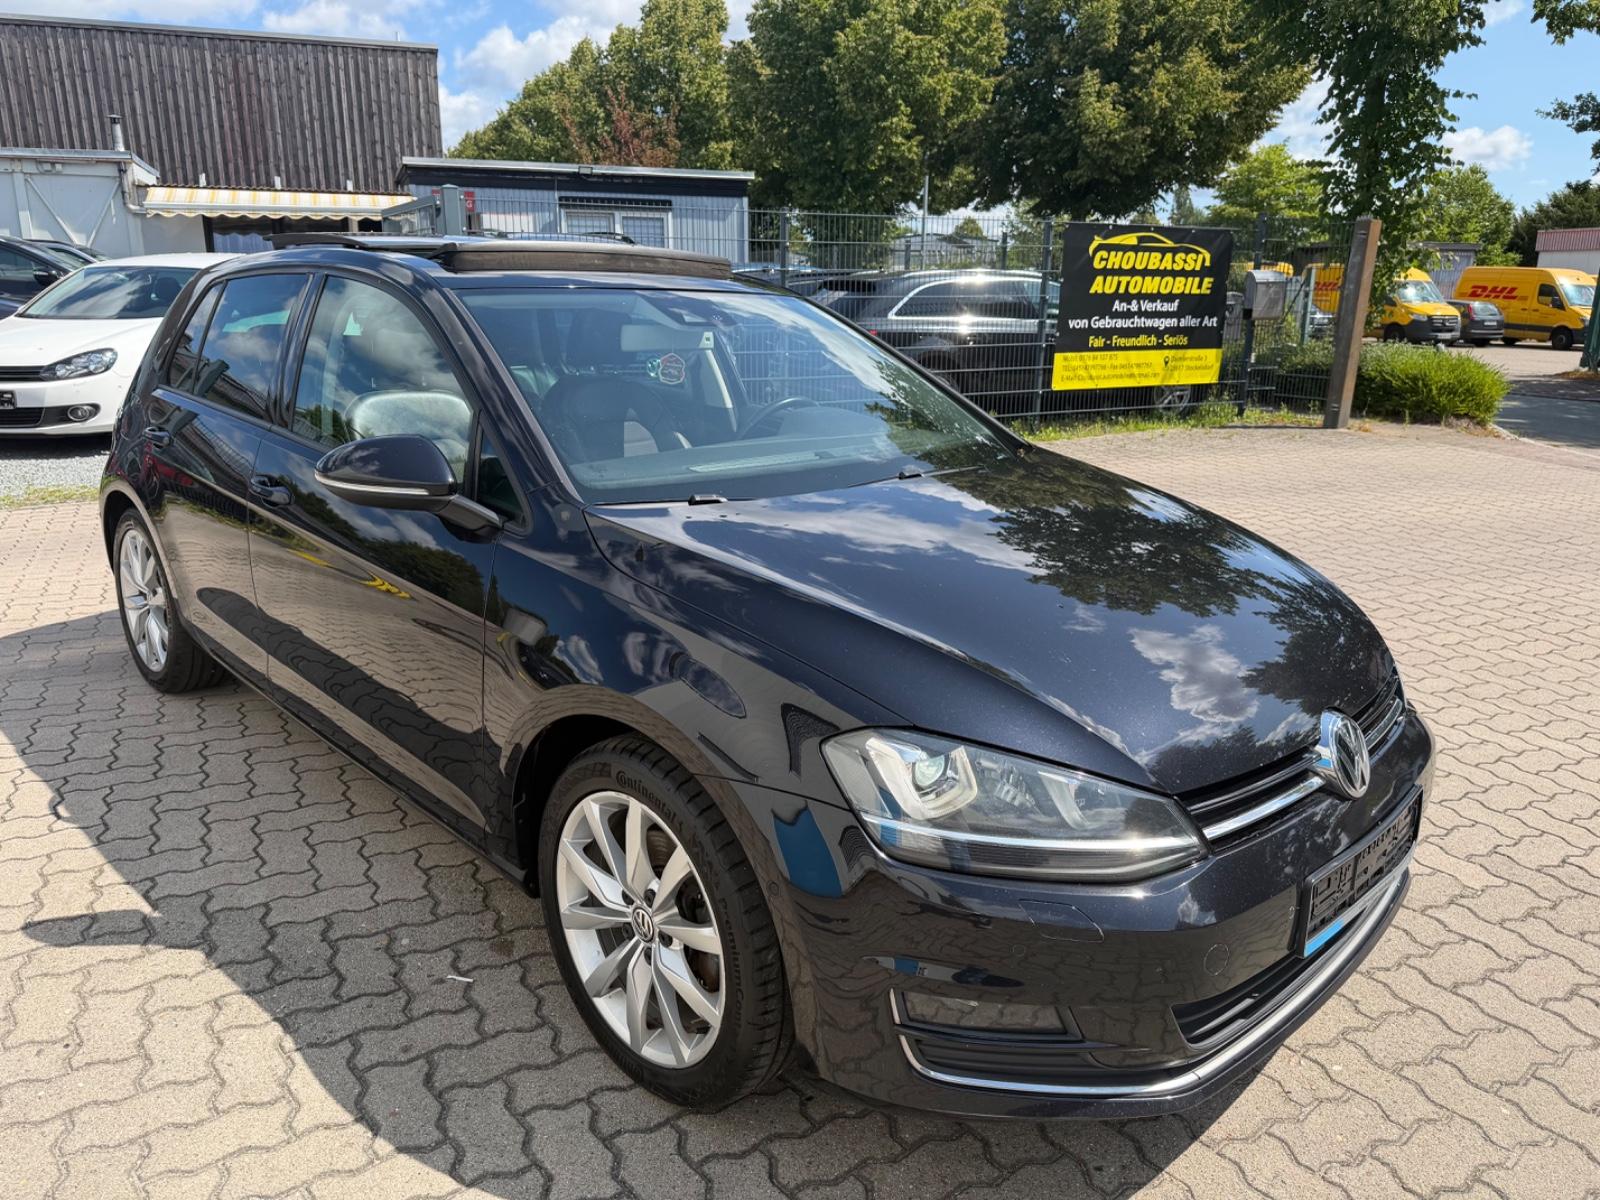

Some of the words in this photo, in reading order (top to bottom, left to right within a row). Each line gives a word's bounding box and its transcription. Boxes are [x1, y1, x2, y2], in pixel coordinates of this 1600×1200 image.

[1093, 250, 1203, 271] CHOUBASSI
[1089, 275, 1214, 295] AUTOMOBILE
[1468, 285, 1518, 300] DHL
[1140, 299, 1180, 312] Verkauf
[1068, 319, 1088, 329] von
[1090, 315, 1178, 330] Gebrauchtwagen
[1179, 316, 1200, 327] aller
[1202, 316, 1217, 327] Art
[1088, 335, 1105, 348] Fair
[1112, 334, 1157, 347] Freundlich
[1163, 334, 1188, 346] Seriös
[615, 770, 677, 823] Continental
